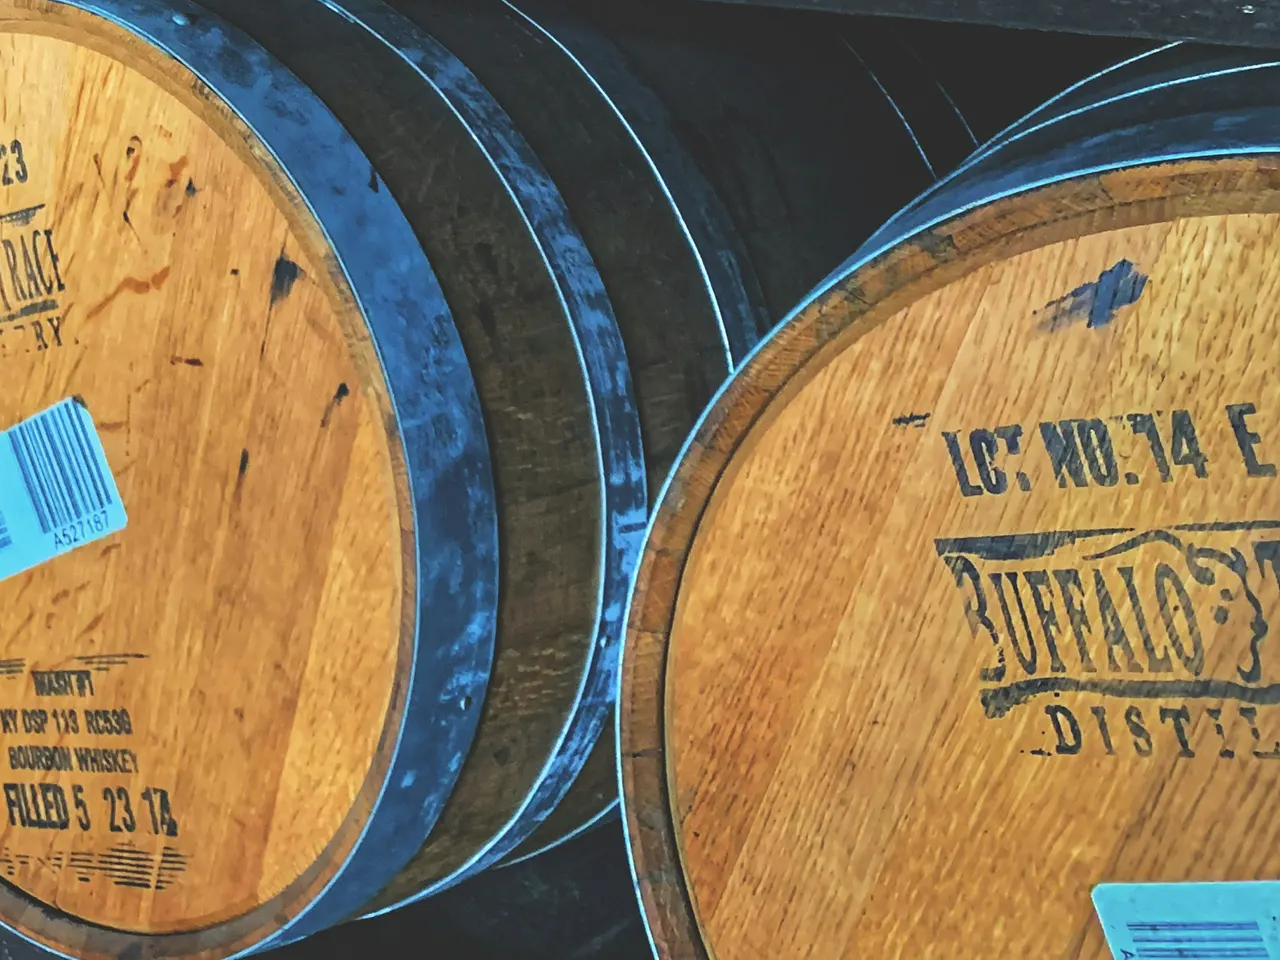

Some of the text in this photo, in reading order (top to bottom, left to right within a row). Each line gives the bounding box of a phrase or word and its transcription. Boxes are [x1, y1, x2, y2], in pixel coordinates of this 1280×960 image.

[1225, 402, 1277, 478] E
[54, 510, 111, 551] A527187
[943, 554, 1205, 682] BUFFALO
[0, 708, 18, 734] KY
[21, 708, 49, 734] DSP
[51, 708, 80, 734] 113
[8, 745, 139, 774] BOURBON WHISKEY
[3, 782, 70, 830] FILLED
[72, 784, 91, 832] 5
[103, 786, 136, 832] 23
